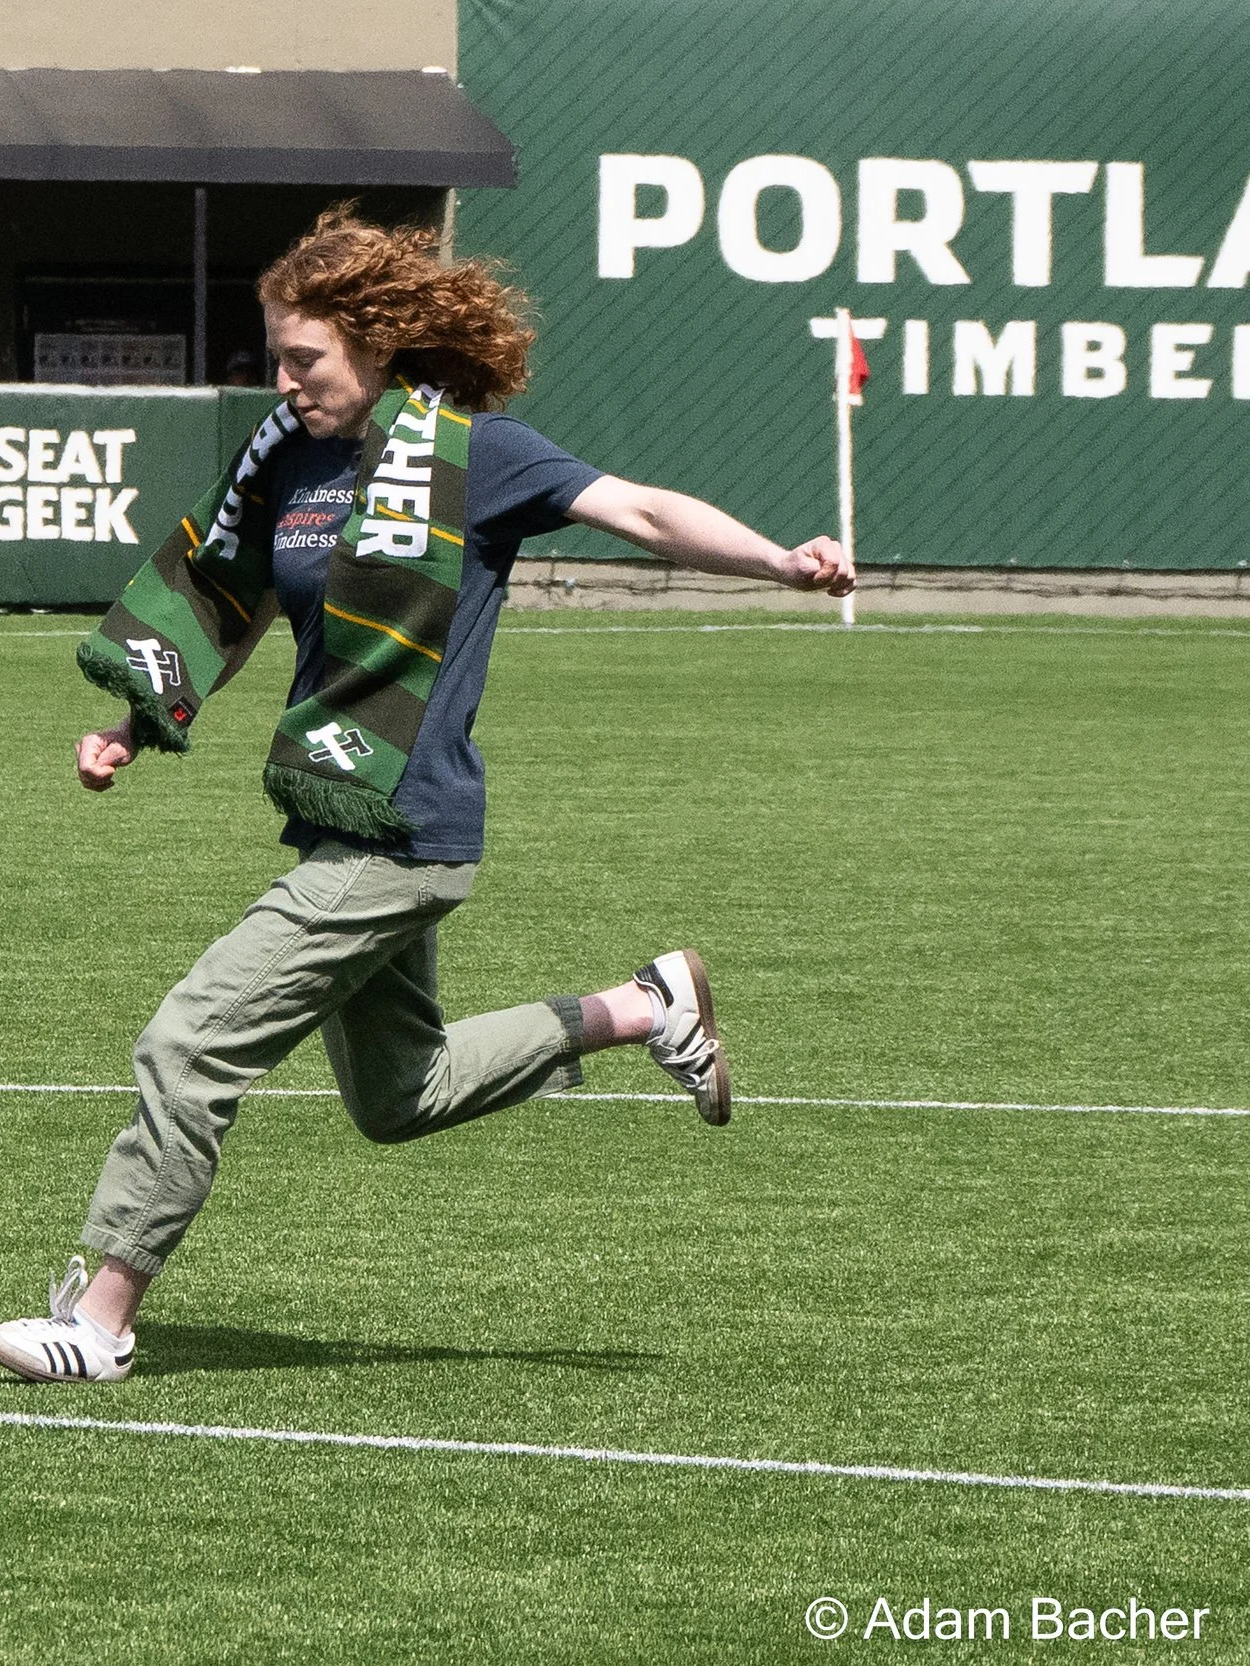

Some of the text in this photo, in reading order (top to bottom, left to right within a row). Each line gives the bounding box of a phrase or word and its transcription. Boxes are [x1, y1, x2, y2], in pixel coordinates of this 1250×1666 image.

[809, 317, 1250, 400] TIMBE
[288, 484, 354, 505] Kindness
[356, 383, 444, 557] THER
